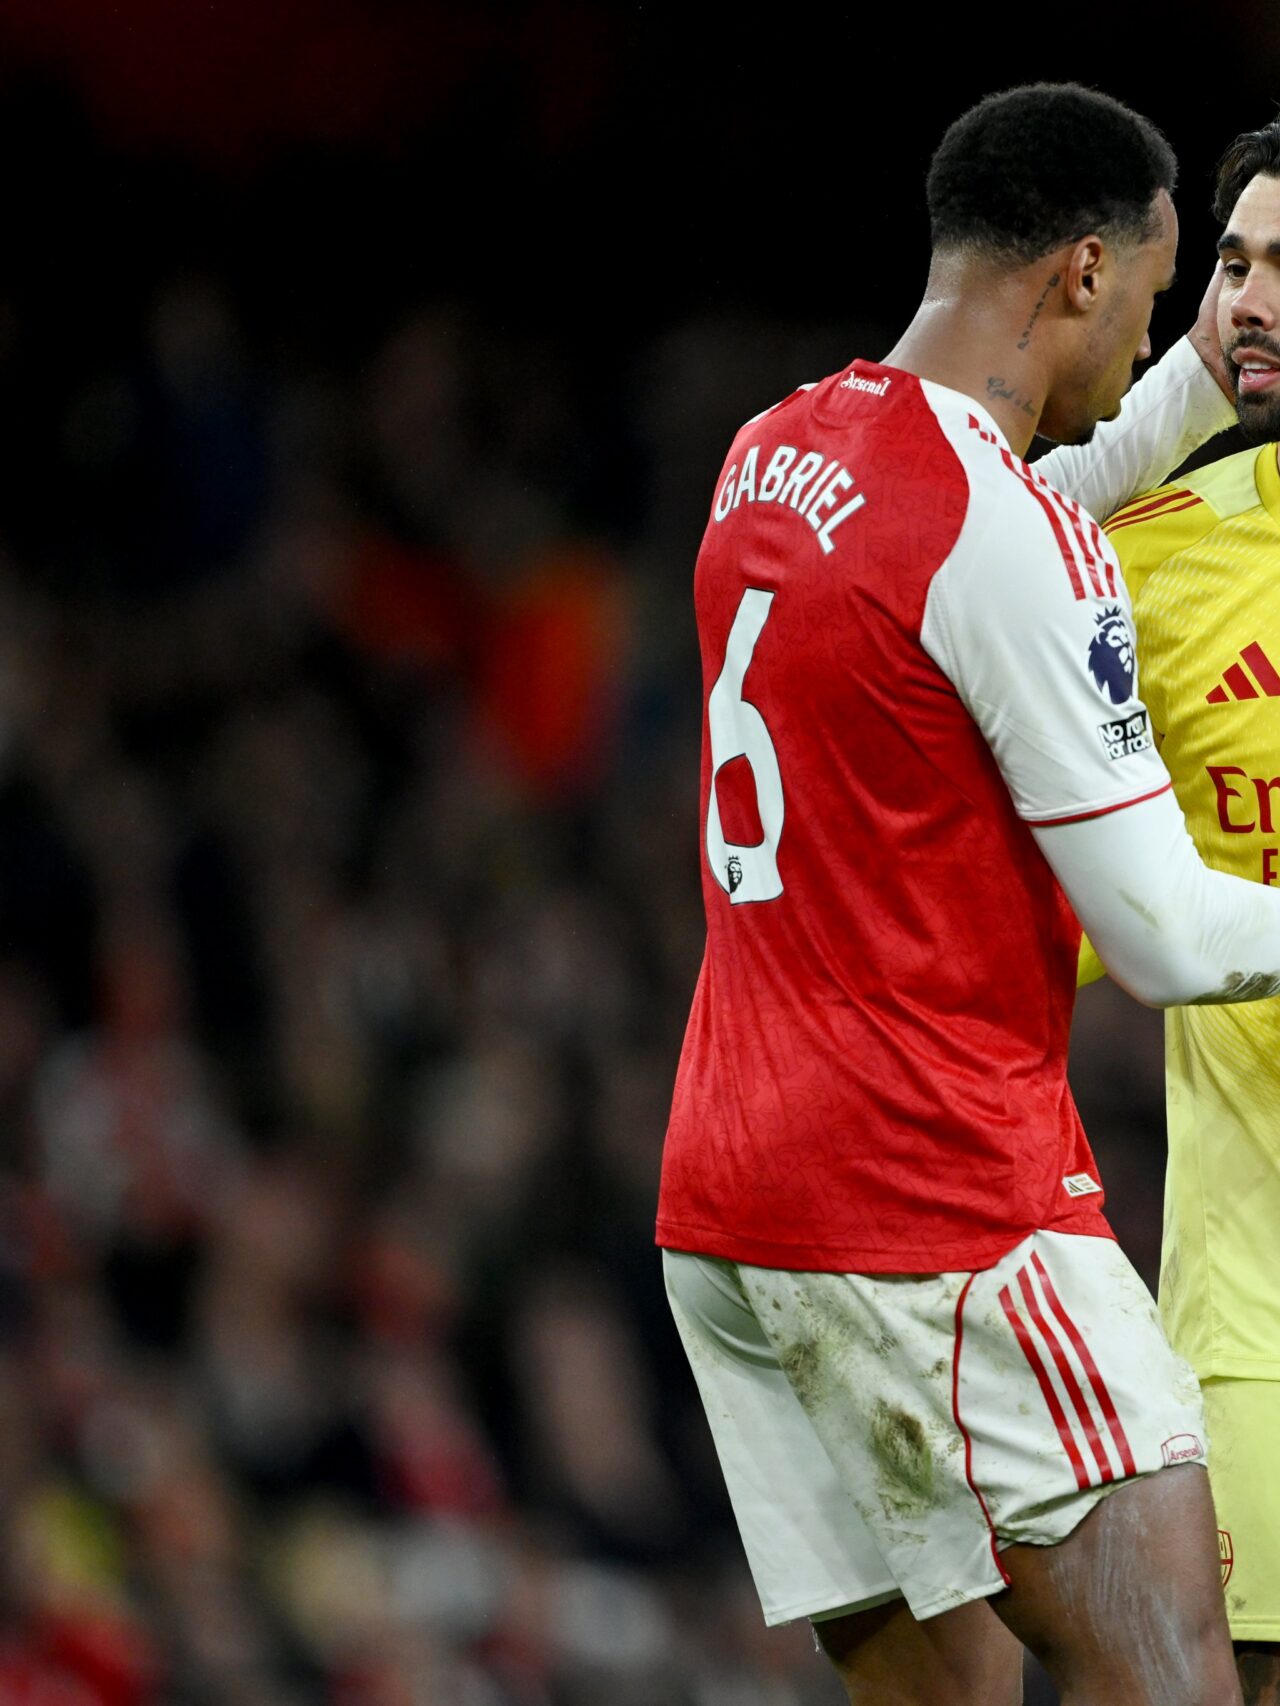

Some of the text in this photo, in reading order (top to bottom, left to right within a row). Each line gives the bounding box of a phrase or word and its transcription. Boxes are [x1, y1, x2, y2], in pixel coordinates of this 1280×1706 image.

[840, 371, 891, 397] Arsenal
[714, 445, 866, 555] GABRIEL
[706, 586, 785, 906] 6
[1098, 723, 1124, 743] No
